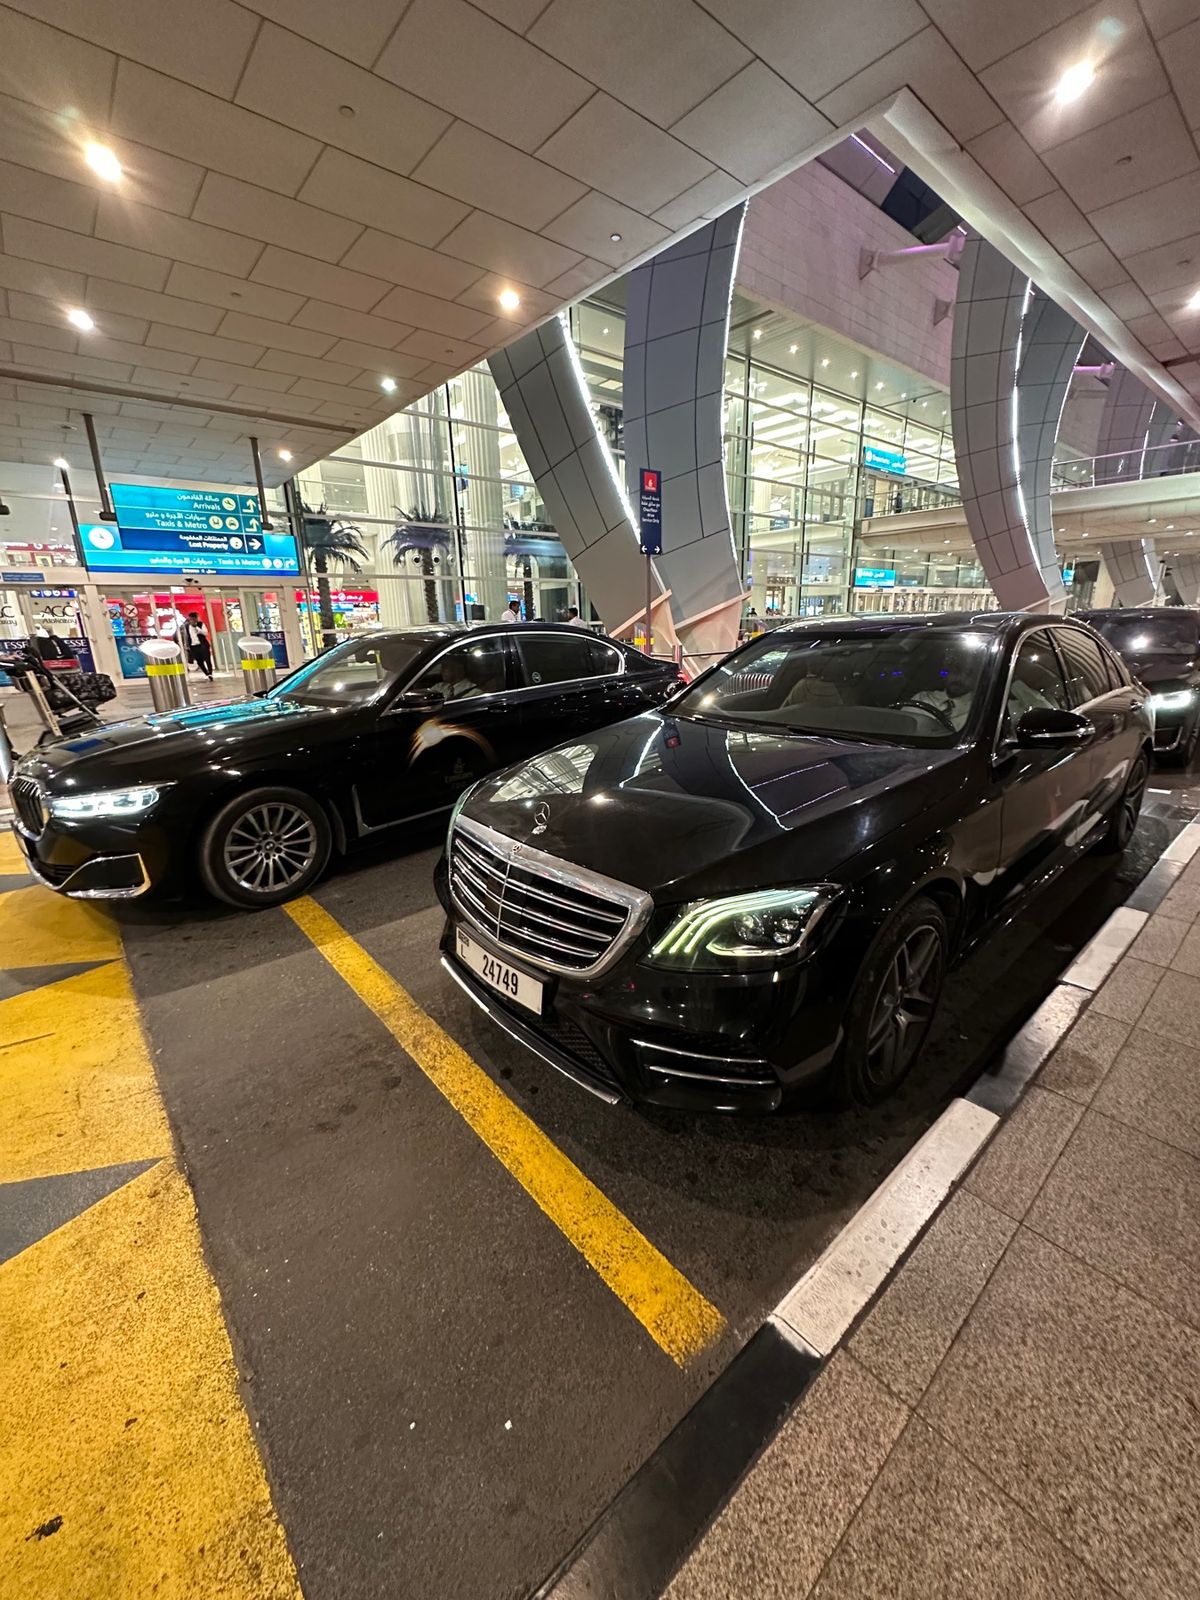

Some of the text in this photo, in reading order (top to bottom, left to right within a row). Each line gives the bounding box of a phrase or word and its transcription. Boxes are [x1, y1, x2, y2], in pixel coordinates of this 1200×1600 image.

[193, 502, 221, 511] Arrivals
[155, 519, 208, 530] Taxis & Metro
[188, 541, 229, 551] Lost Property
[482, 954, 519, 996] 24749
